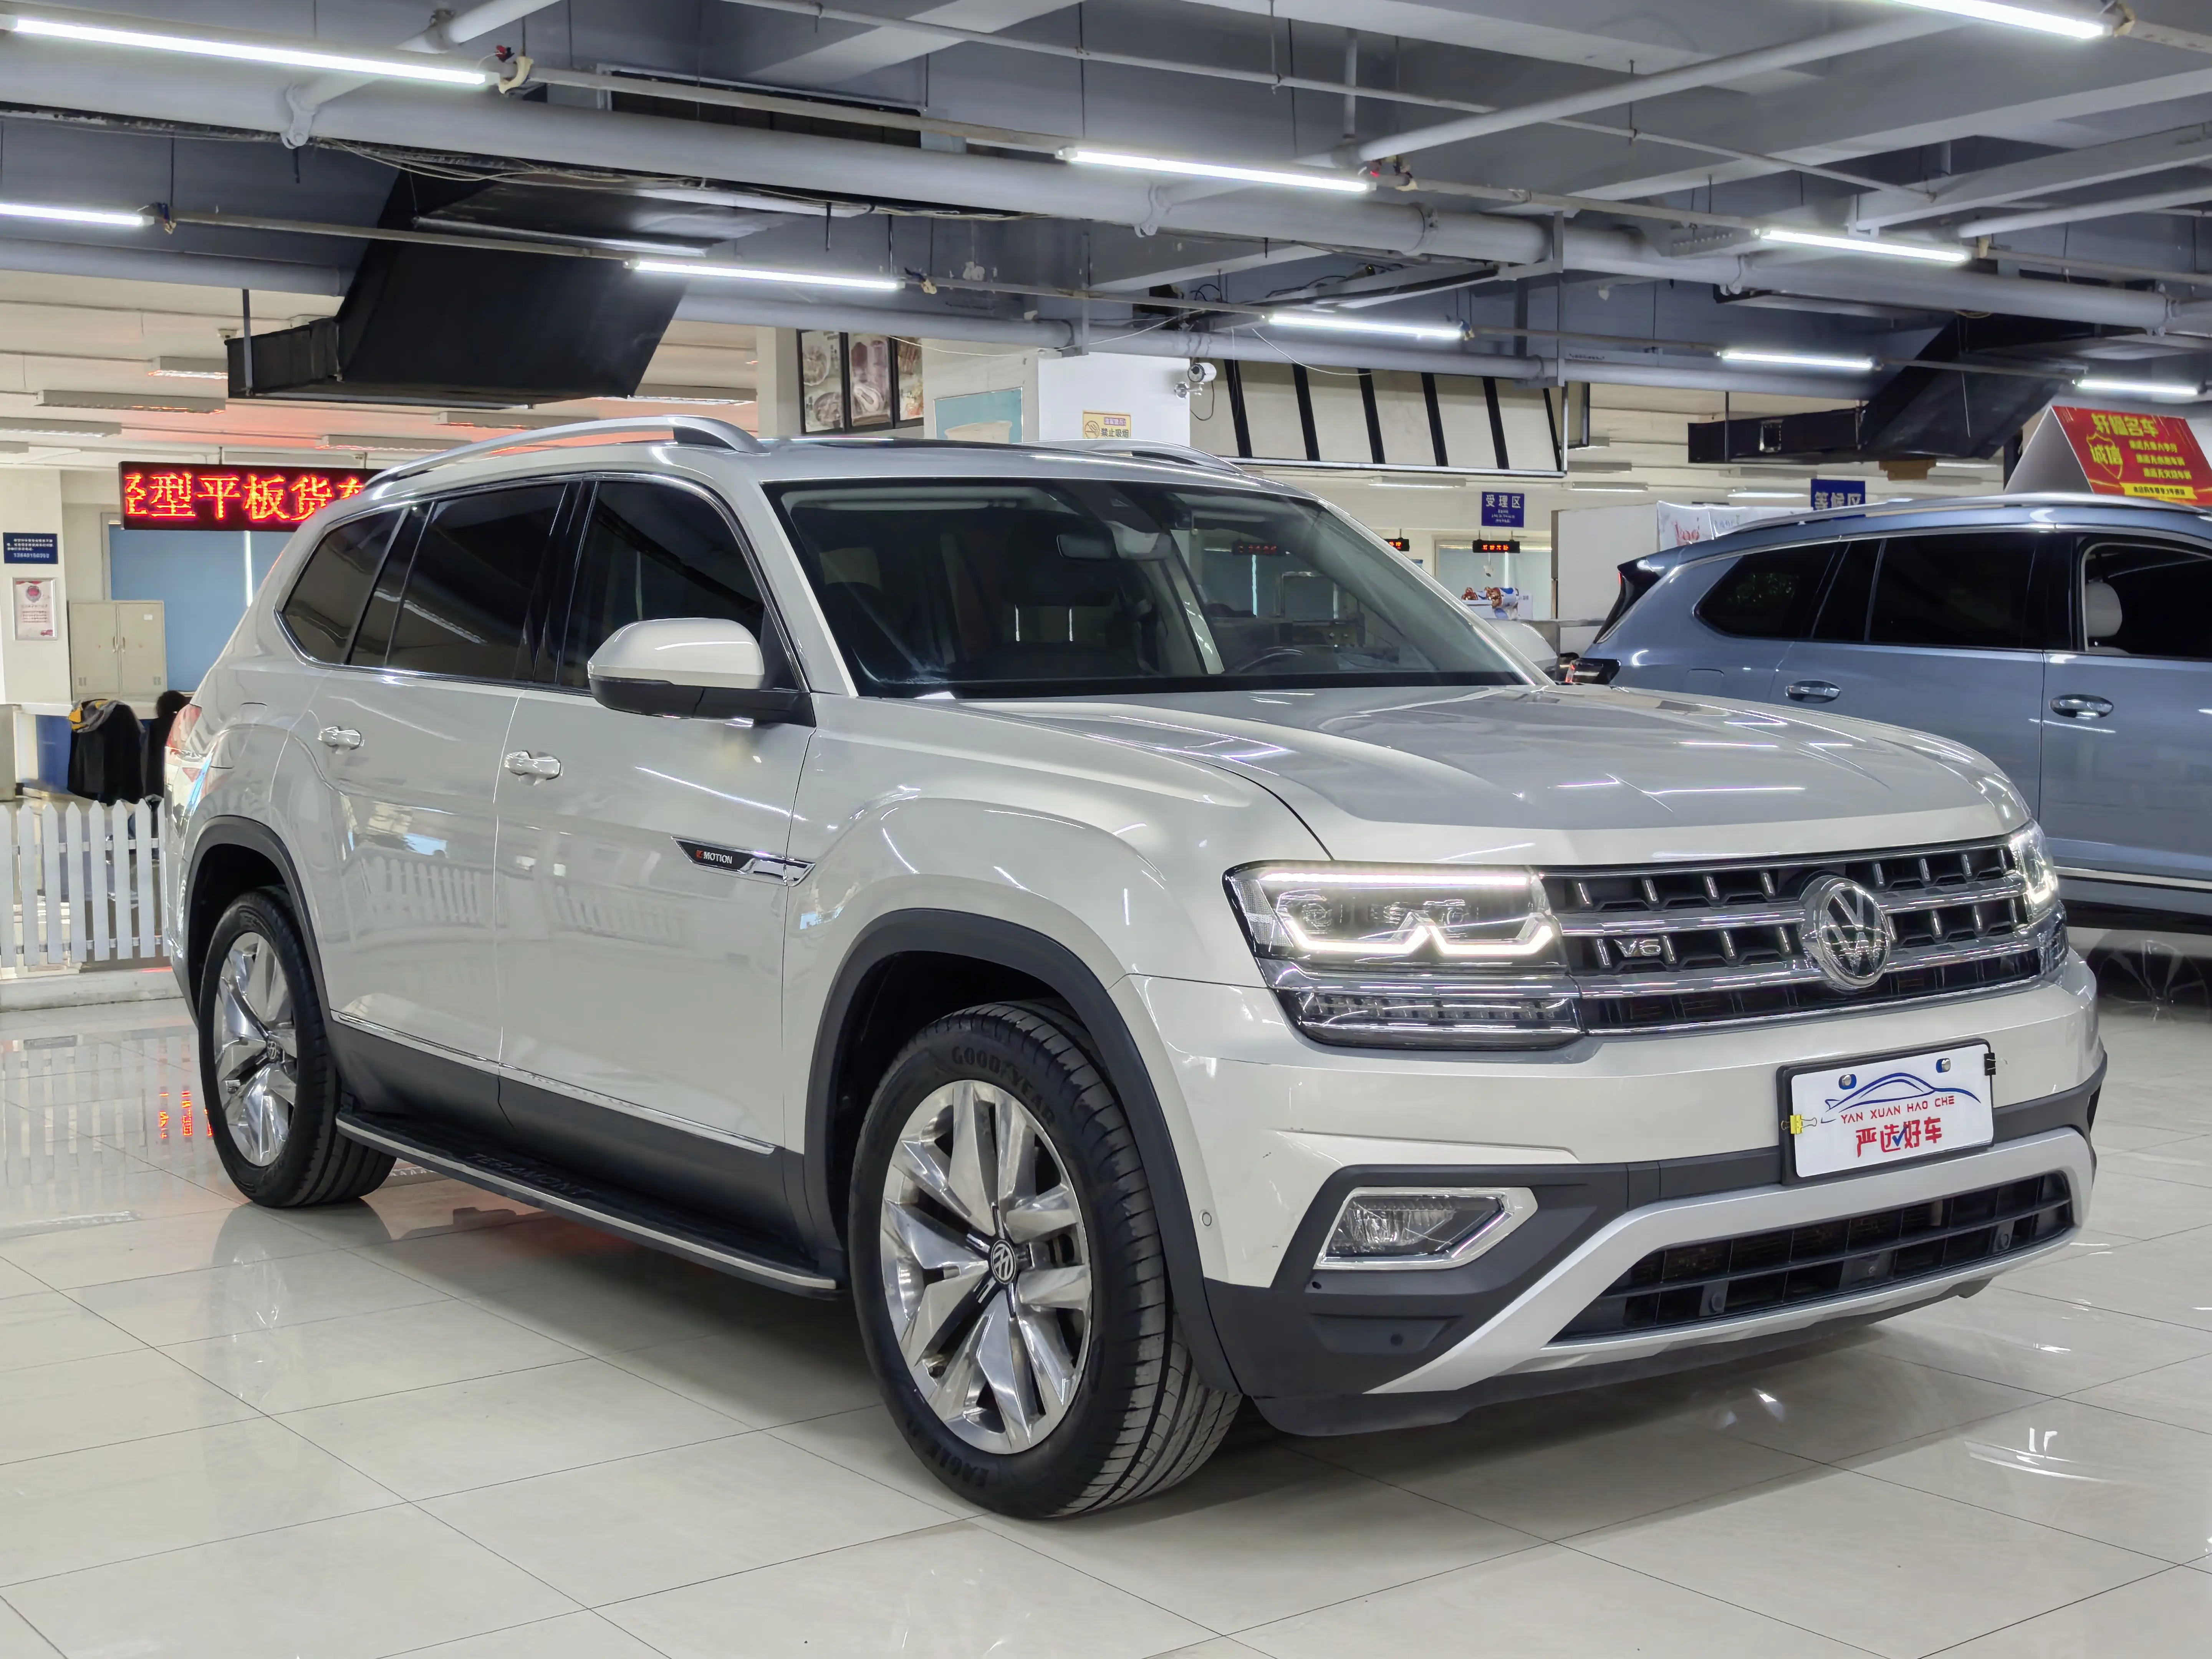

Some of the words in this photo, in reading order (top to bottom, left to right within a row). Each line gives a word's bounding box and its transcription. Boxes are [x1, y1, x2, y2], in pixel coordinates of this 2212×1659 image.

[1486, 494, 1521, 509] 受理区
[1815, 491, 1861, 510] 等候区
[1614, 939, 1661, 957] V6
[1841, 1111, 1863, 1124] YAN
[1870, 1104, 1901, 1120] XUAN
[1907, 1100, 1928, 1111] HAO
[1935, 1095, 1955, 1107] CHE
[1855, 1117, 1942, 1158] 严选好车
